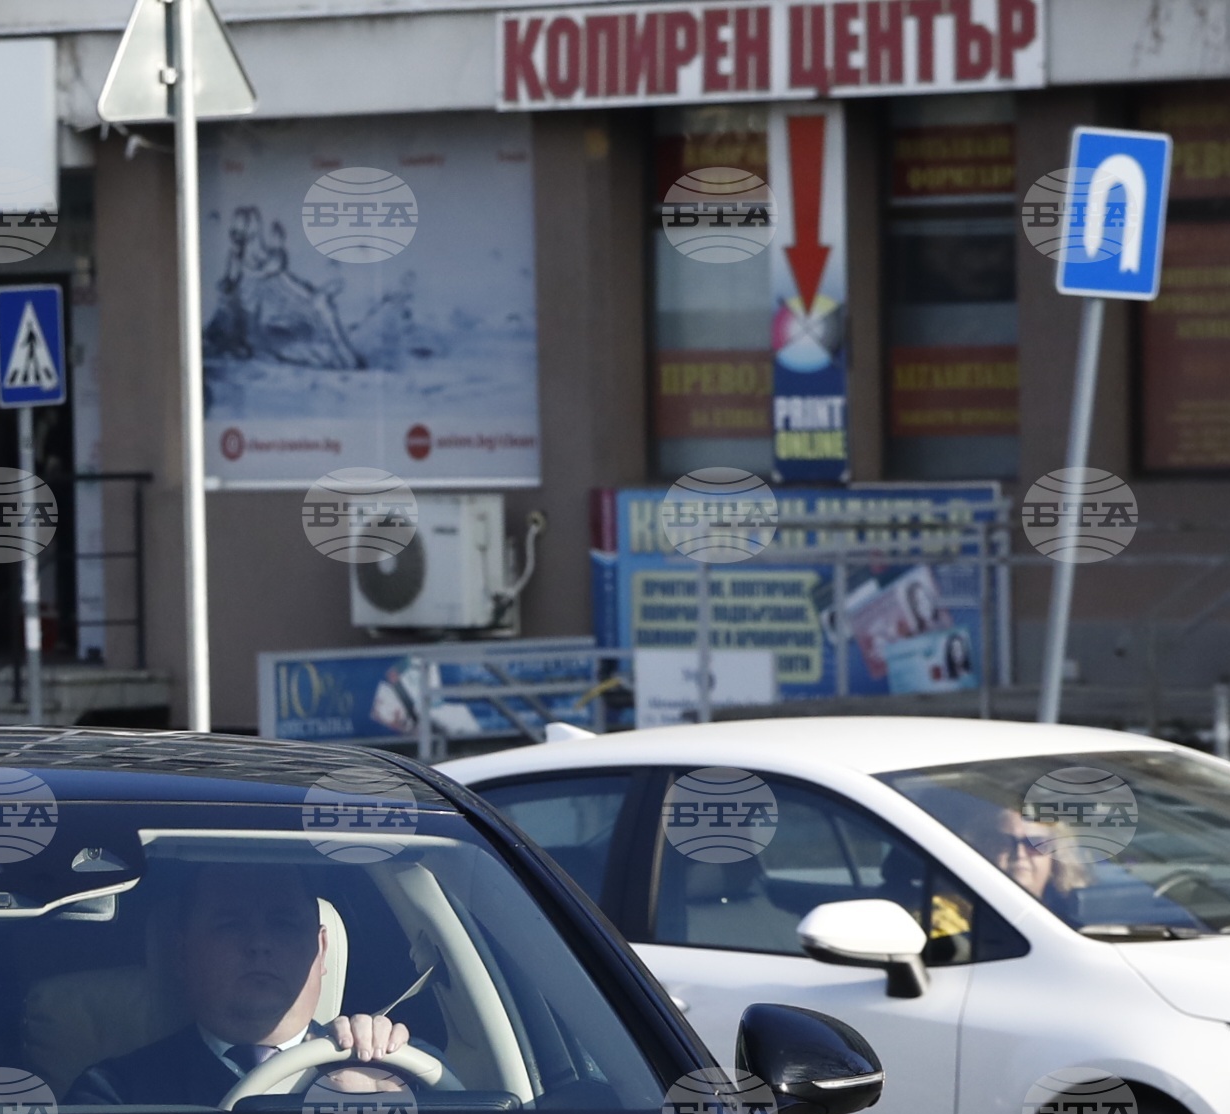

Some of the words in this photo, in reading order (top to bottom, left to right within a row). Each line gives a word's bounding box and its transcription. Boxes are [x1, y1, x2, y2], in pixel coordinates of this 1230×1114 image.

[503, 8, 771, 102] КОПИРЕН
[787, 0, 1038, 97] ЦЕНТЪР
[774, 395, 845, 431] PRINT
[775, 430, 846, 460] ONLINE
[277, 660, 354, 720] 10%
